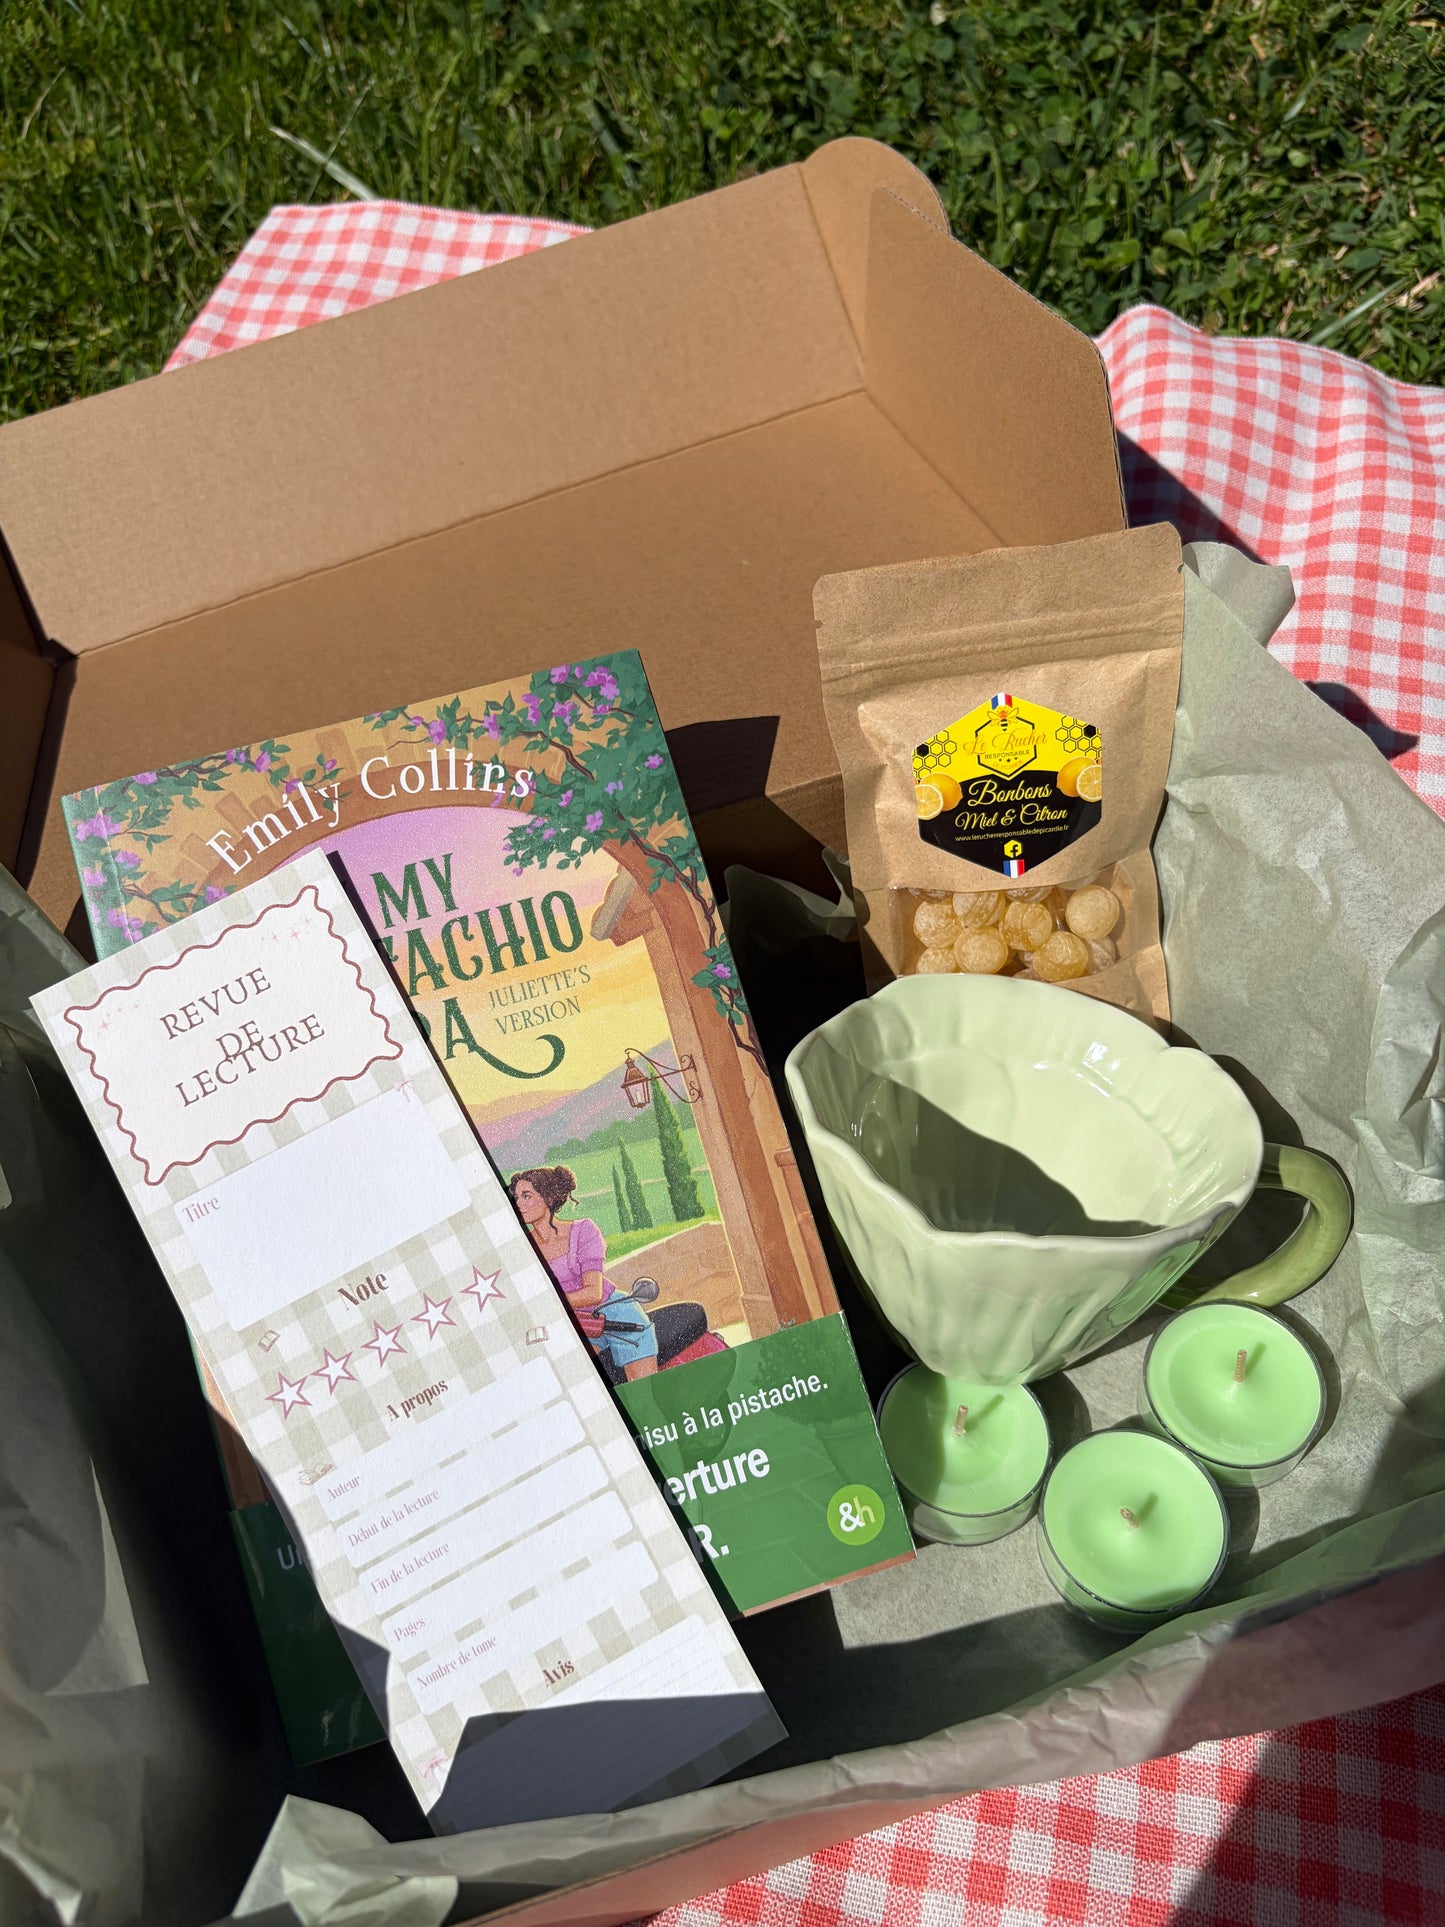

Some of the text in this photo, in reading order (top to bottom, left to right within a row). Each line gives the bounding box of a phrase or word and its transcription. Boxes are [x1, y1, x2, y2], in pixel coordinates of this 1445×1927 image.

[963, 728, 1048, 755] Le Rucher
[985, 749, 1031, 760] RESPONSABLE
[206, 747, 535, 875] Emily Collins
[967, 779, 1053, 807] Bonbons
[955, 803, 1069, 831] Miel & Citron
[955, 825, 1070, 842] www.lerucherresponsabledepicardie.fr
[370, 853, 459, 930] MY
[160, 967, 272, 1040] REVUE
[488, 964, 591, 1011] JULIETTE'S
[495, 995, 582, 1036] VERSION
[175, 1014, 326, 1108] LECTURE
[215, 1020, 265, 1061] DE
[182, 1196, 222, 1223] Titre
[337, 1273, 390, 1311] Note
[386, 1379, 449, 1422] A propos
[682, 1412, 698, 1436] à
[700, 1407, 724, 1429] la
[727, 1374, 829, 1426] pistache.
[327, 1476, 361, 1502] Auteur
[658, 1448, 771, 1507] erture
[347, 1490, 440, 1549] Début de la lecture
[370, 1543, 449, 1594] Fin de la lecture
[393, 1617, 427, 1642] Pages
[416, 1635, 498, 1690] Nombre de tome
[542, 1659, 575, 1688] Avis
